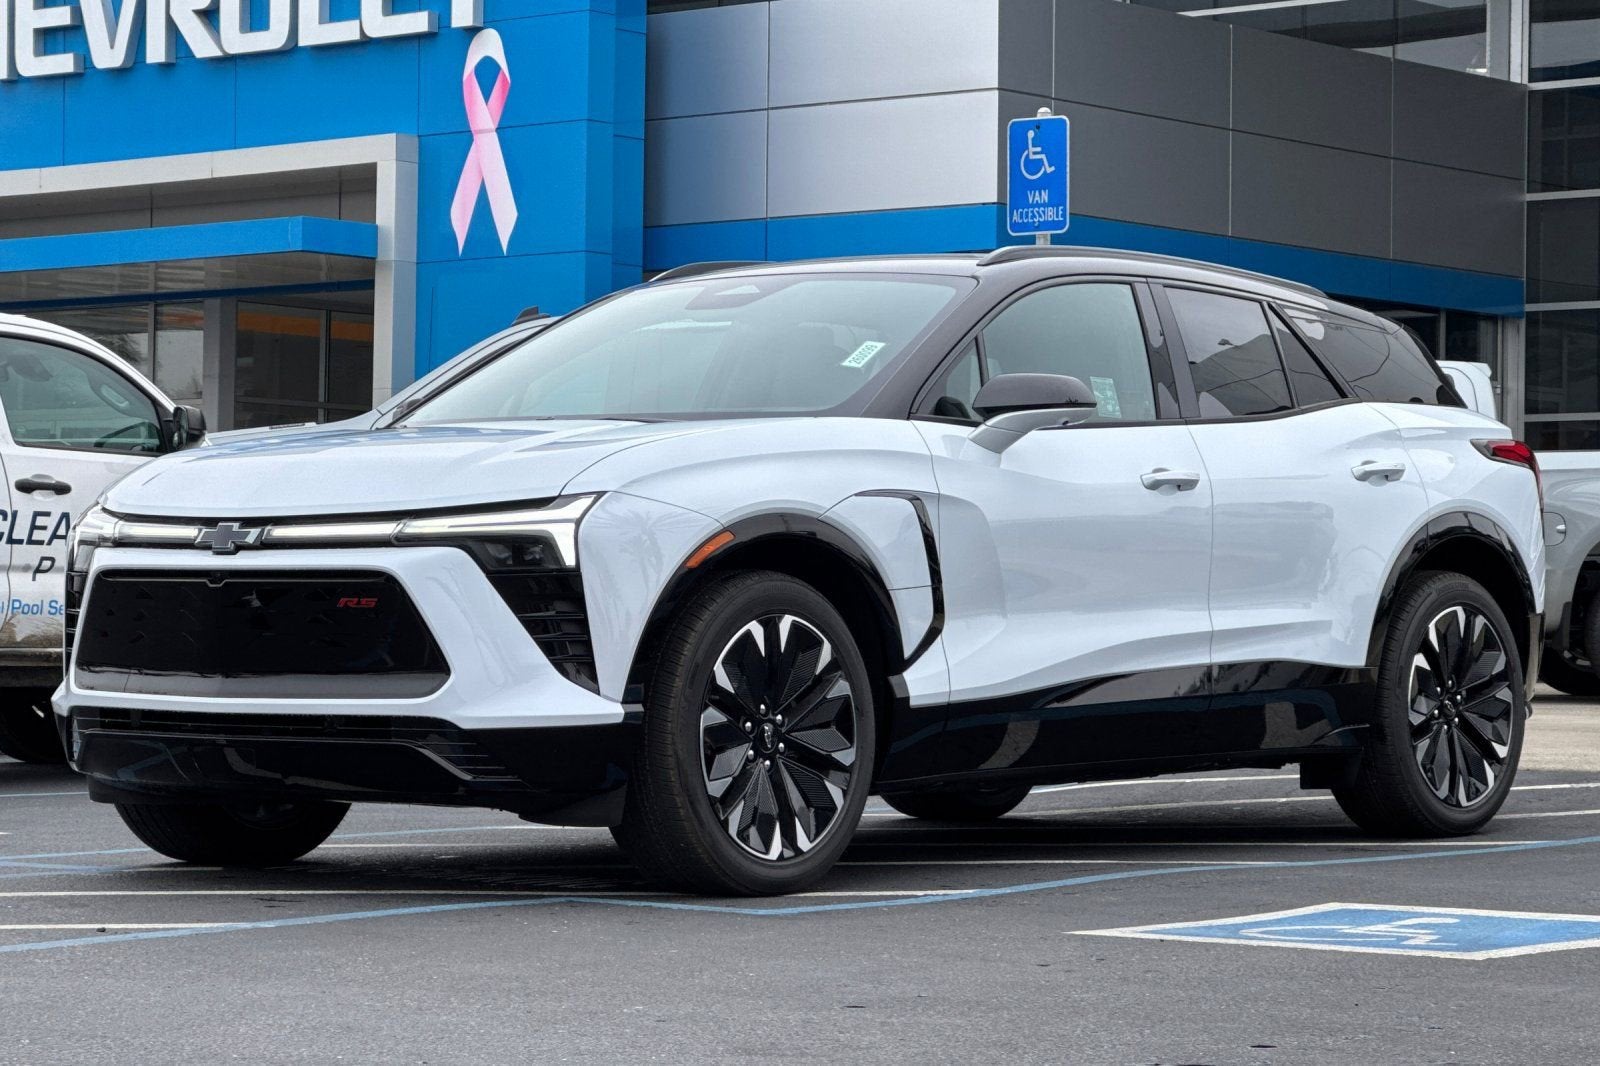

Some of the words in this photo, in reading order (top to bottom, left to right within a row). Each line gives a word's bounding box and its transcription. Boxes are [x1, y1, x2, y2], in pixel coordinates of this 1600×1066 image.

[1027, 189, 1049, 204] VAN
[1012, 206, 1064, 223] ACCESSIBLE
[11, 599, 44, 616] Pool
[337, 597, 378, 608] RS
